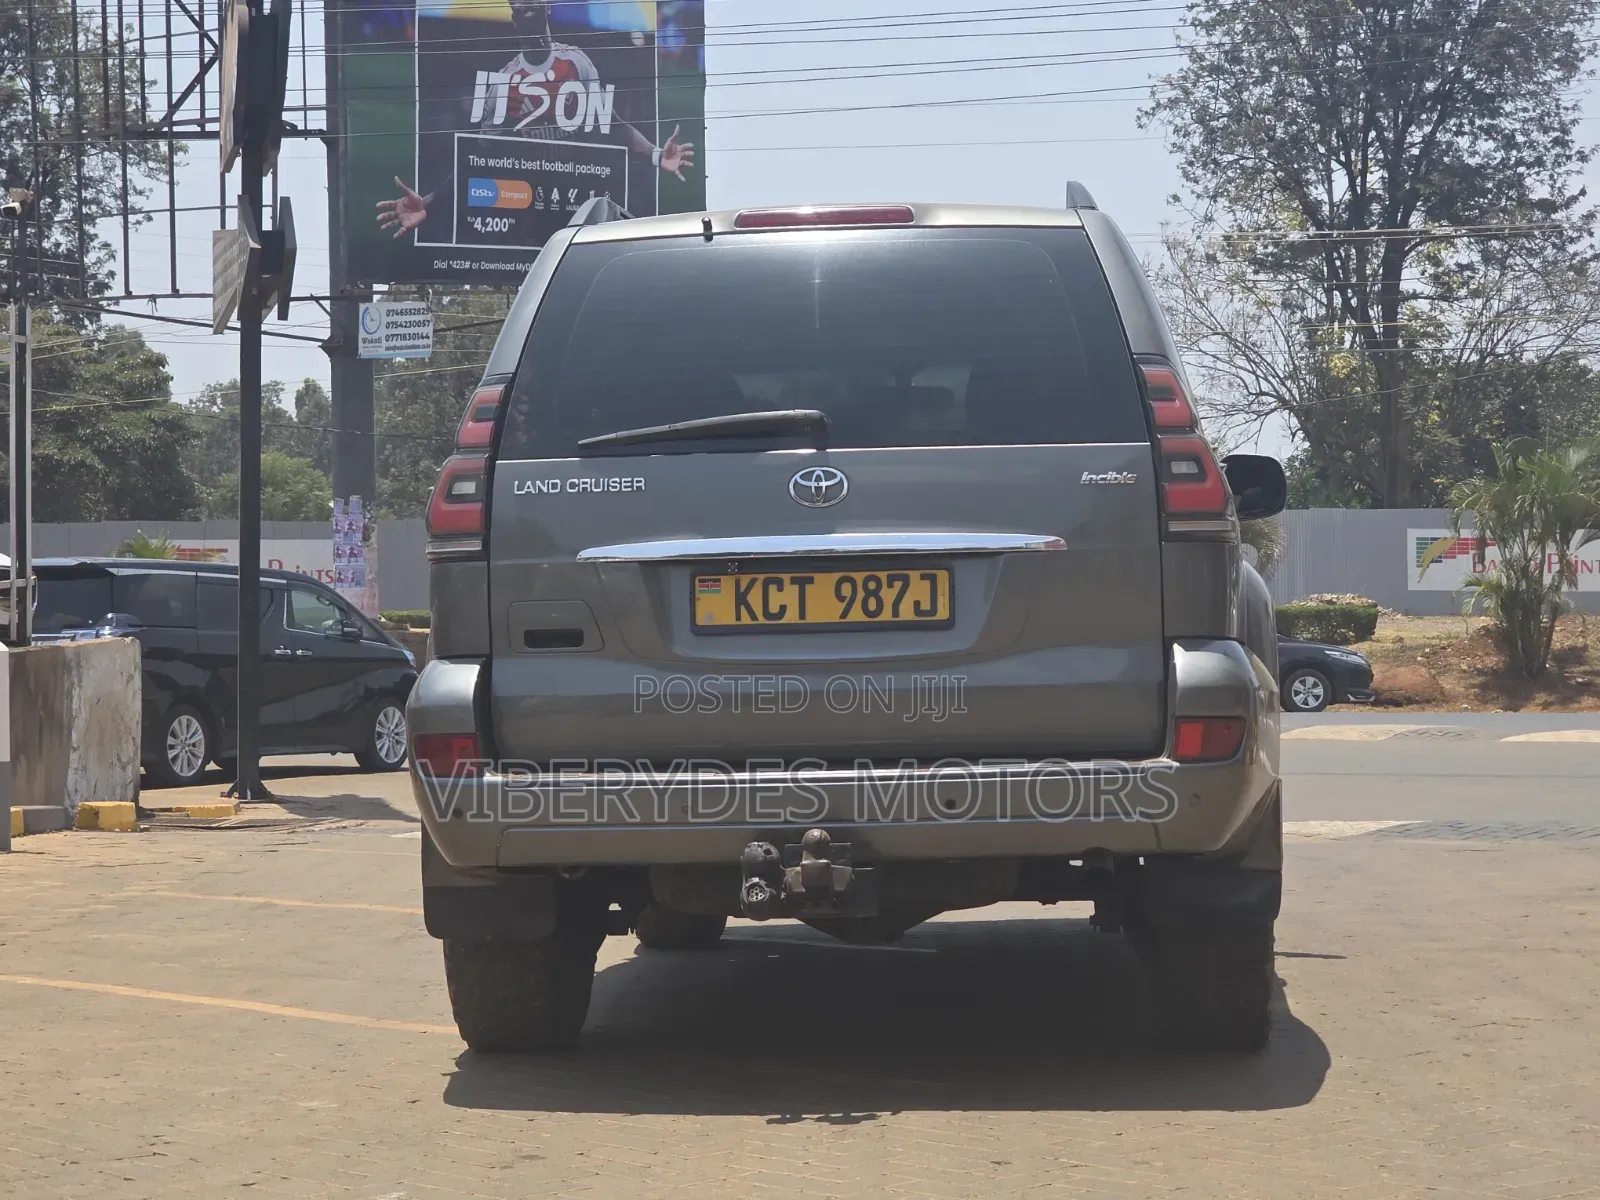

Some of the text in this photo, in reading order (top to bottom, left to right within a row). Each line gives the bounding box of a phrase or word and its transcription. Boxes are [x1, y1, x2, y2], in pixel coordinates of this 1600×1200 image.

[470, 70, 615, 134] IT'S ON
[468, 155, 611, 177] The world's best football package
[471, 188, 528, 200] DStv Compact
[474, 217, 509, 233] 4,200
[433, 260, 448, 269] Dial
[481, 261, 515, 271] Download
[362, 336, 383, 344] Wakati
[514, 477, 645, 495] LAND CRUISER
[734, 575, 815, 622] KCT
[834, 572, 938, 620] 987J
